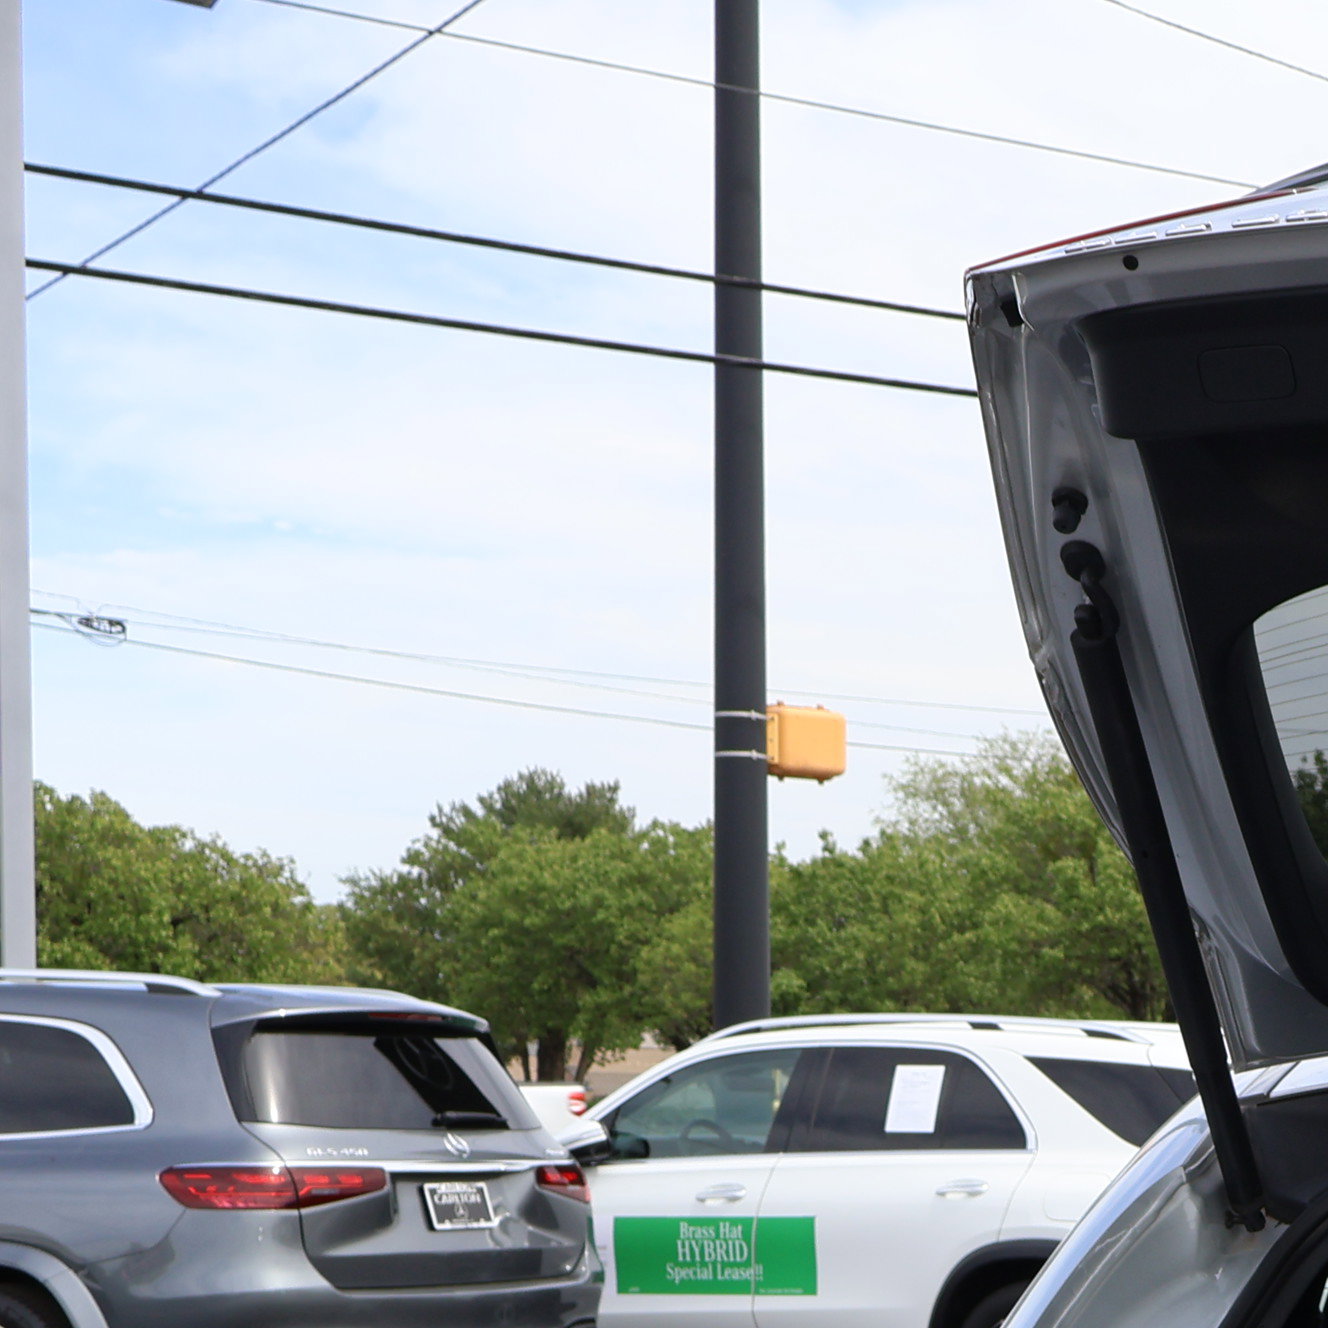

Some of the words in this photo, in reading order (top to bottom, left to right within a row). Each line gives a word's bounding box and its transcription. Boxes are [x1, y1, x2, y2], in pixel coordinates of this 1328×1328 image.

[680, 1221, 715, 1239] Brass
[720, 1221, 742, 1239] Hat
[677, 1239, 749, 1262] HYBRID
[666, 1262, 713, 1285] Special
